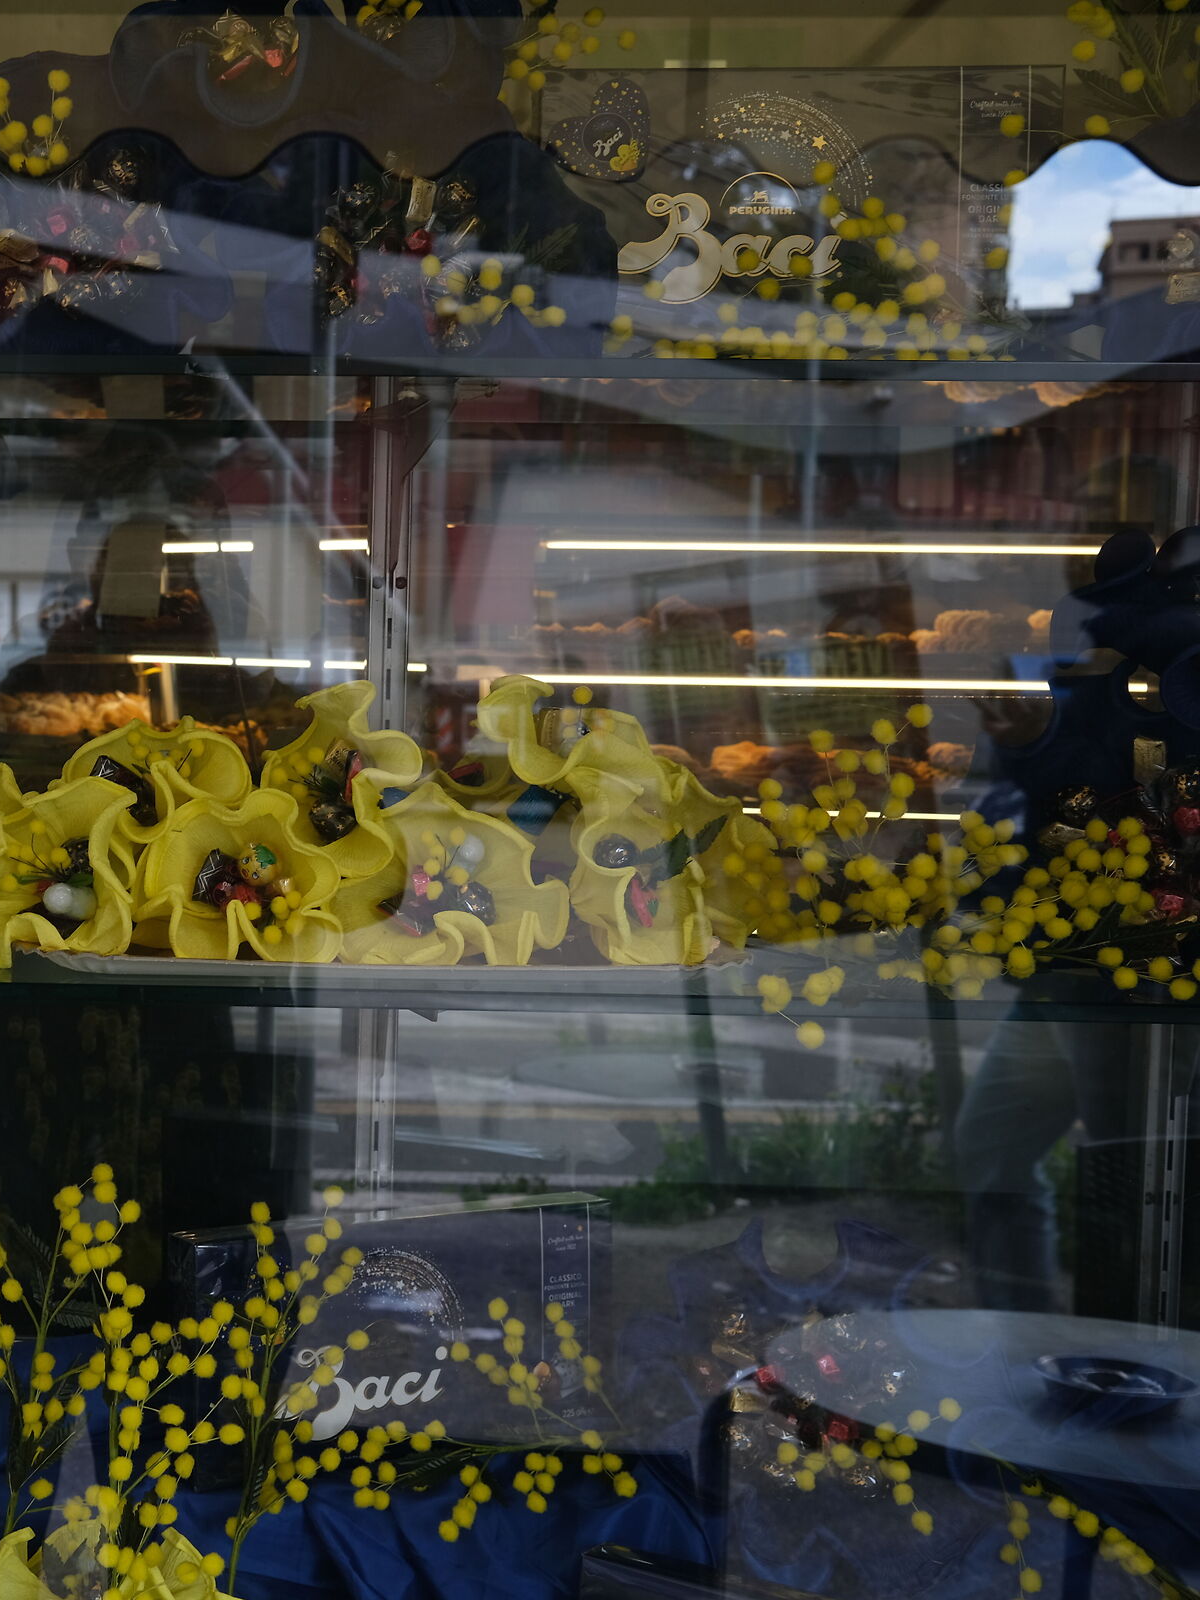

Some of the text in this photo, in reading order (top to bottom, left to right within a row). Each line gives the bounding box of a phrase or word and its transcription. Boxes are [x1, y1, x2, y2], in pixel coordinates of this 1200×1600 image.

[593, 127, 623, 157] Baci
[969, 183, 1006, 192] CLASSI
[729, 206, 792, 215] PERUGINA
[618, 193, 847, 304] Baci
[549, 1273, 582, 1284] CLASSICO
[548, 1291, 583, 1301] ORIGINAL
[273, 1345, 448, 1441] Baci
